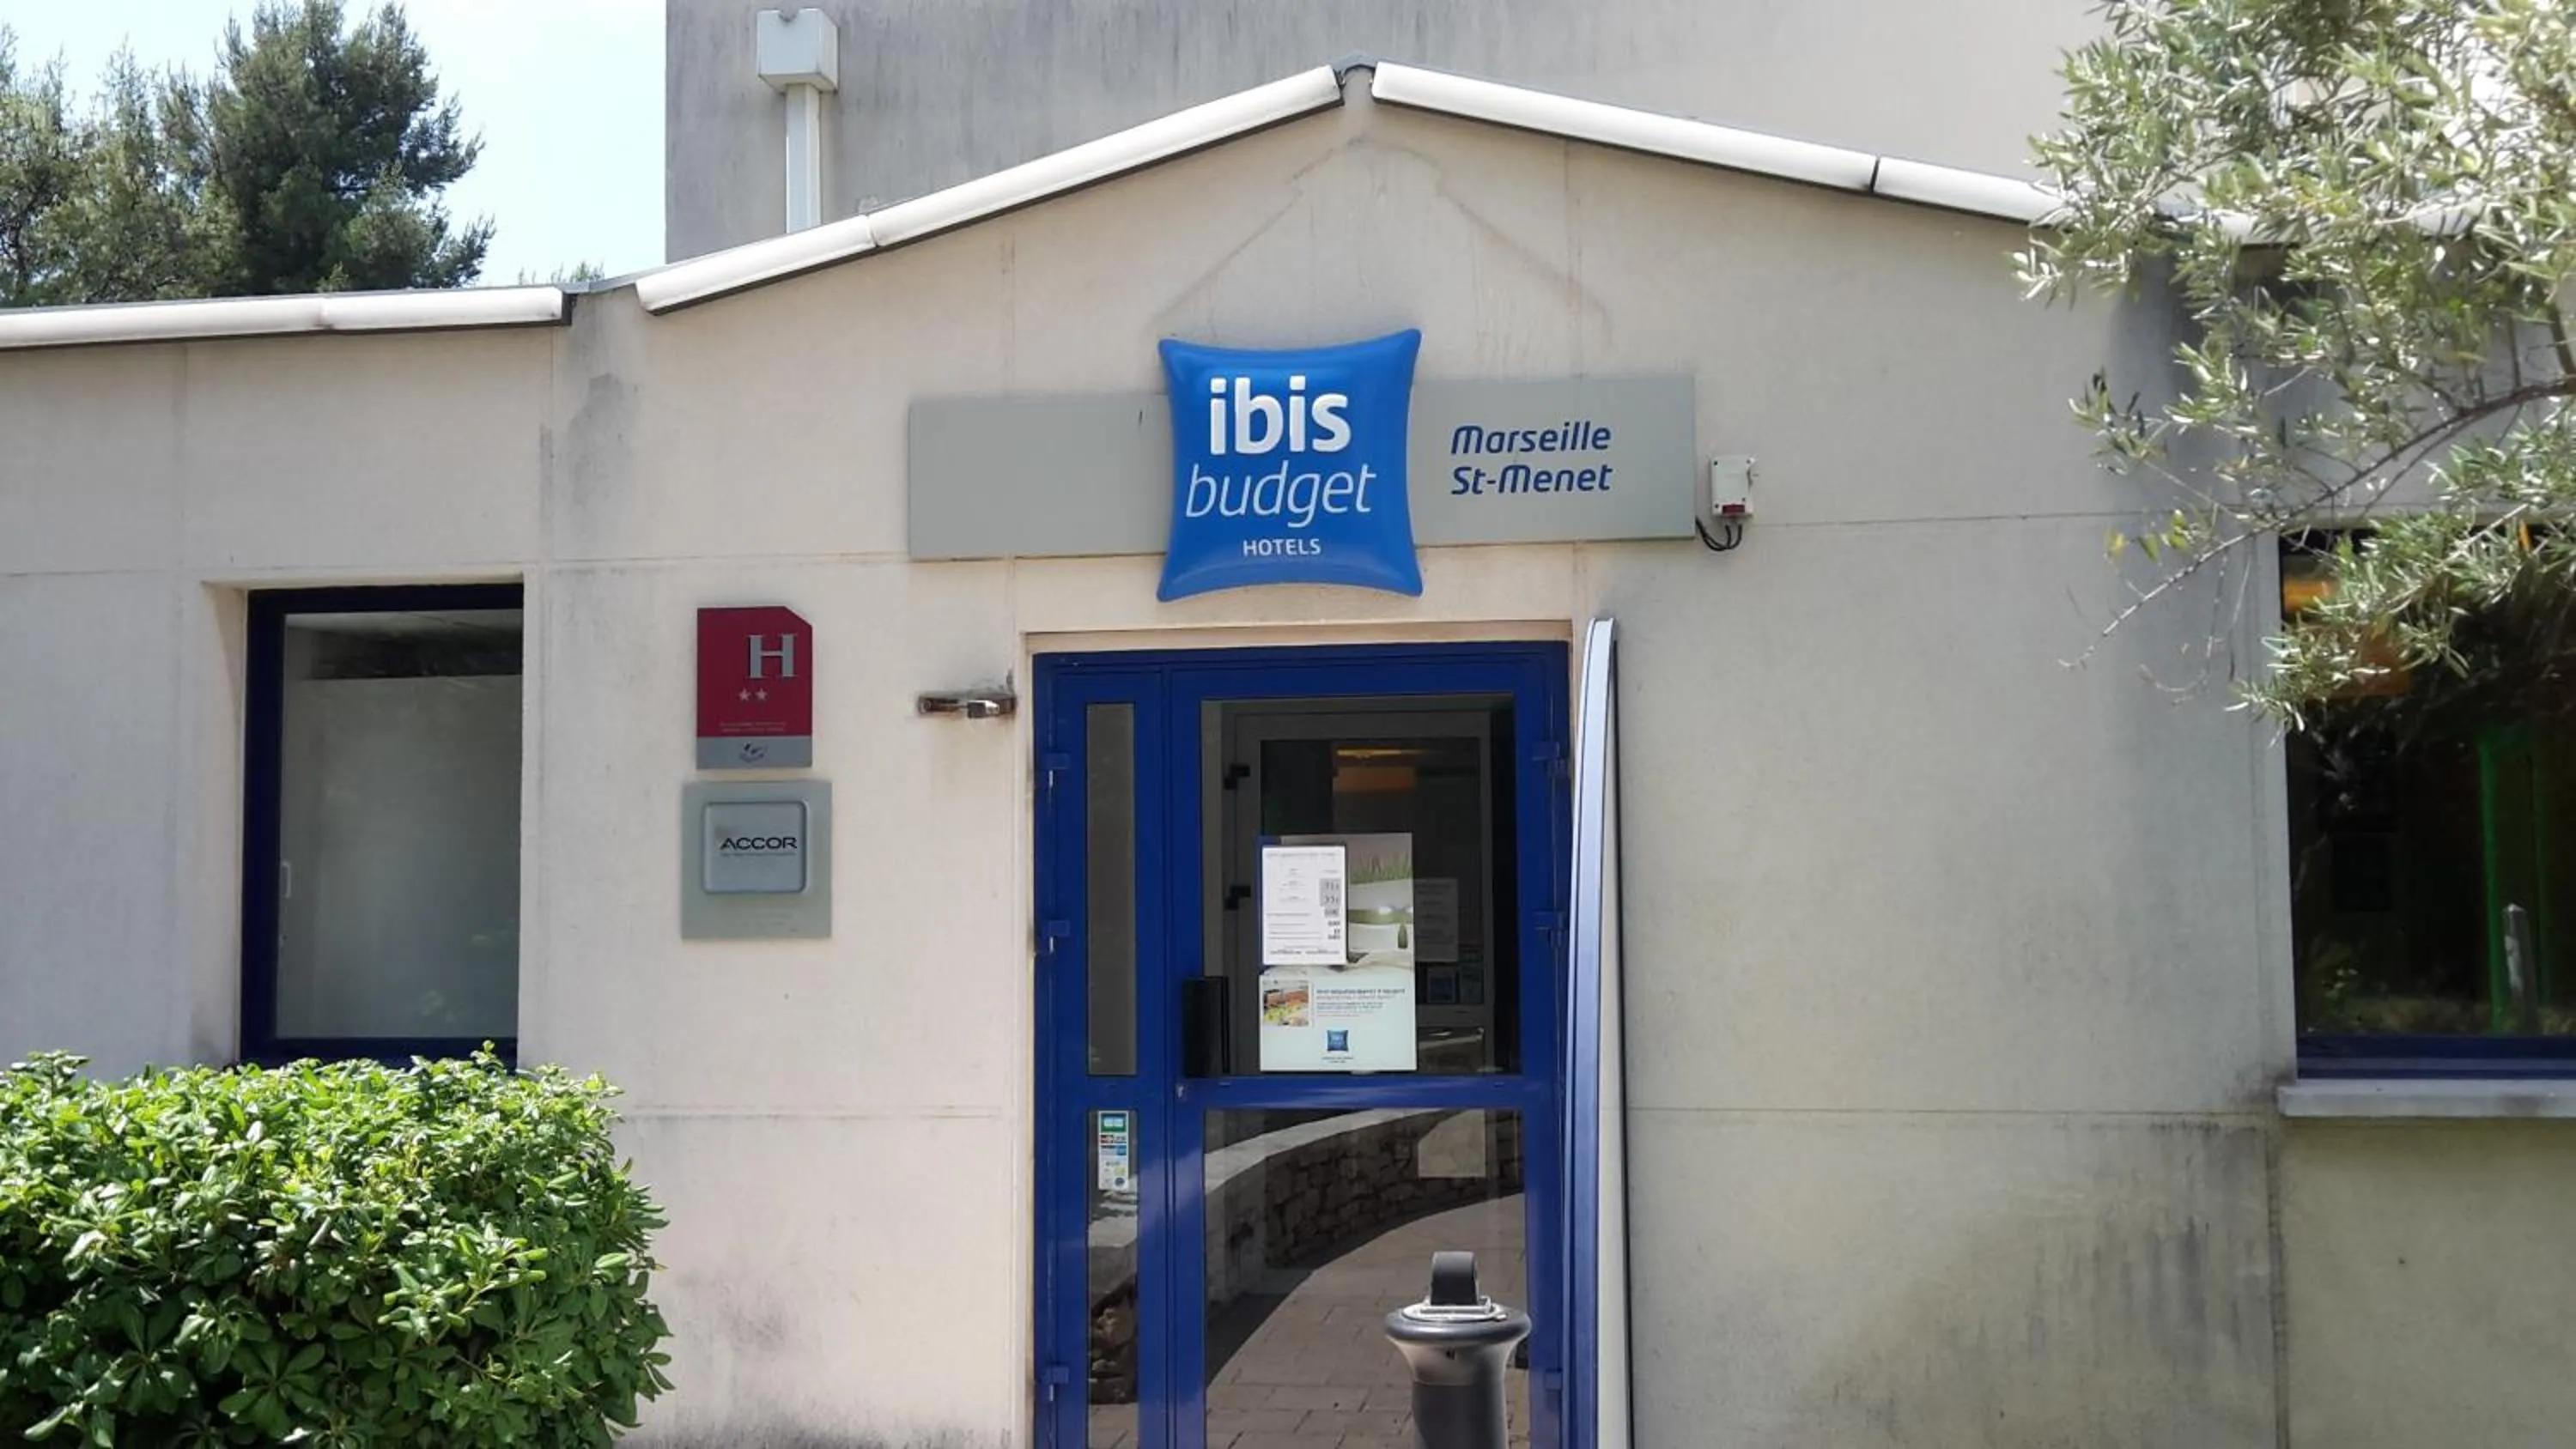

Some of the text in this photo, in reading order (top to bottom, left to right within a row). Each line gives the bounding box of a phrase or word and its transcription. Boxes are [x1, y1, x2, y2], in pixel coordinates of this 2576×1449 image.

[1209, 375, 1352, 456] ibis
[1450, 421, 1612, 454] Marseille
[1185, 459, 1377, 529] budget
[1450, 464, 1613, 495] St-Menet
[1242, 537, 1322, 556] HOTELS
[746, 633, 798, 679] H
[720, 836, 798, 851] ACCOR
